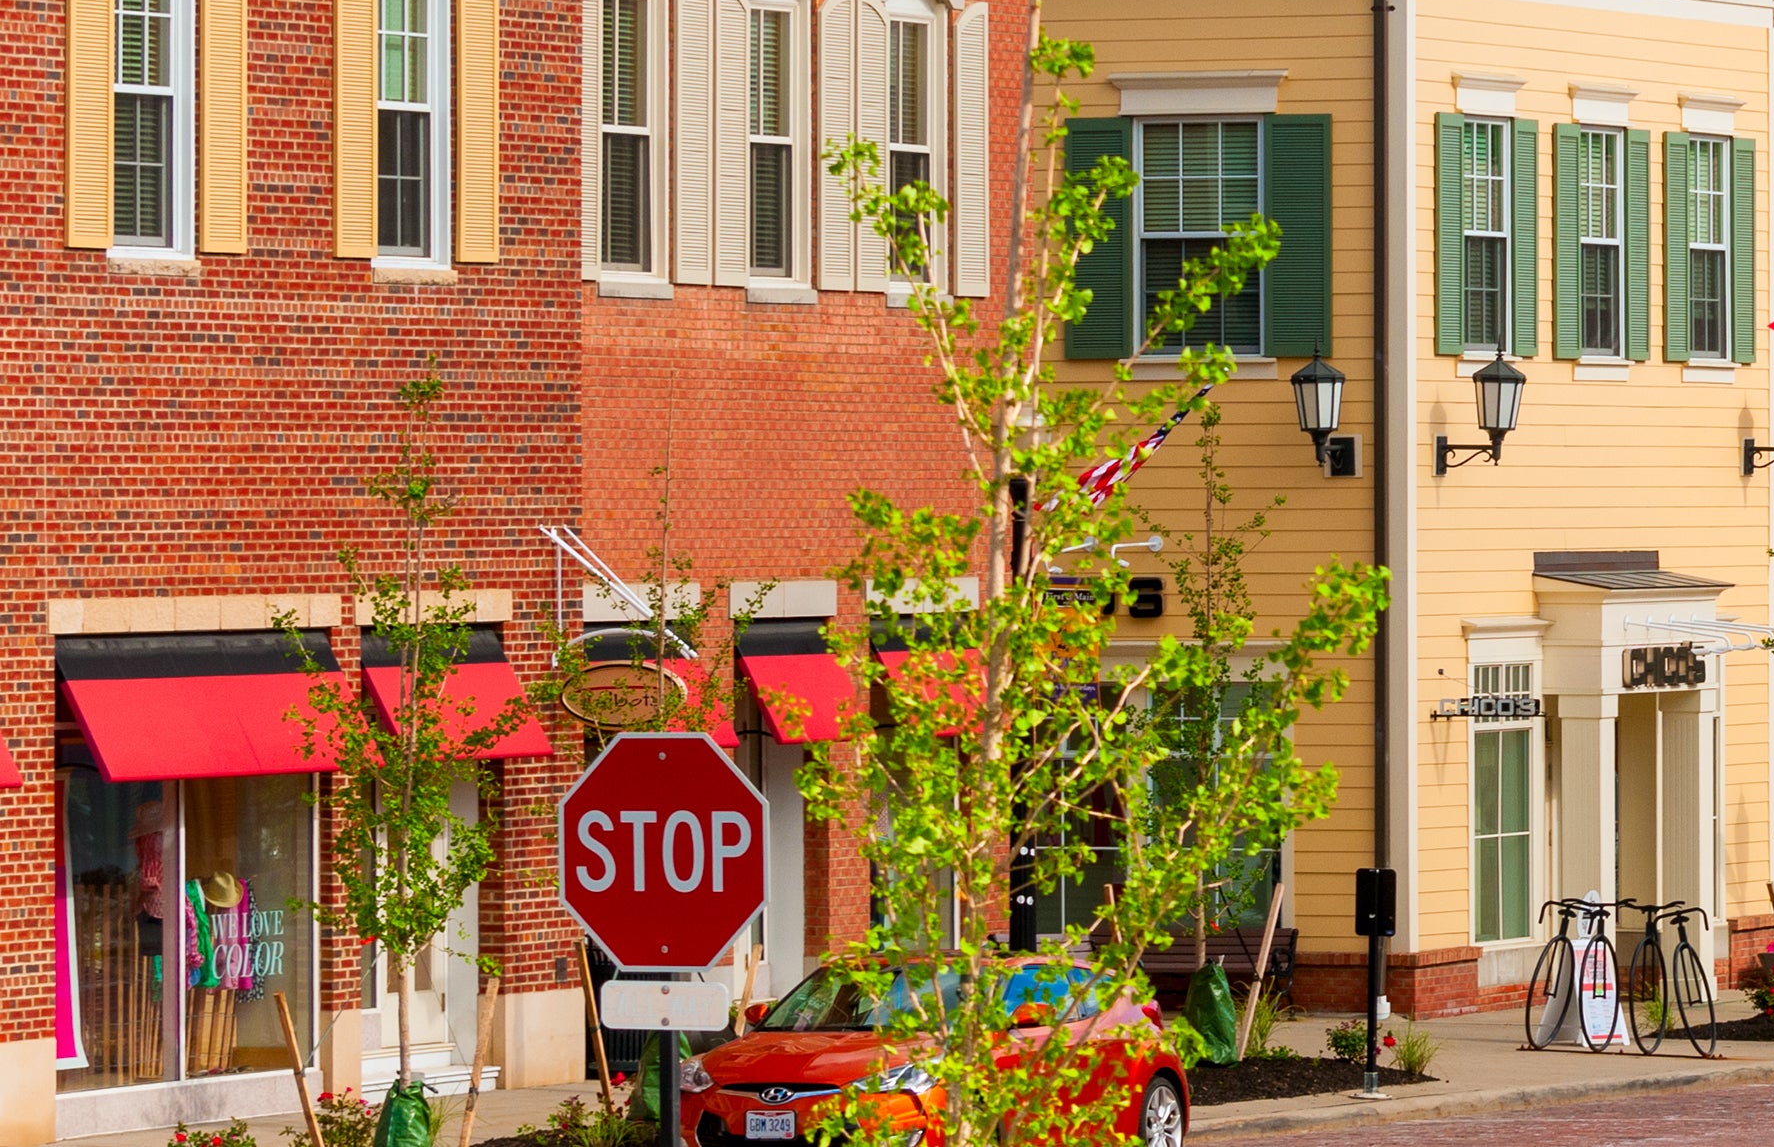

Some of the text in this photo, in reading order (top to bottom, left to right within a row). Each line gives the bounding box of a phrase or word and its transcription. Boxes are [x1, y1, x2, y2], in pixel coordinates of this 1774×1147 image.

[1439, 697, 1537, 716] CHICO'S
[575, 809, 752, 893] STOP
[211, 910, 285, 939] WE LOVE
[212, 941, 285, 979] COLOR
[769, 1118, 791, 1132] 3249
